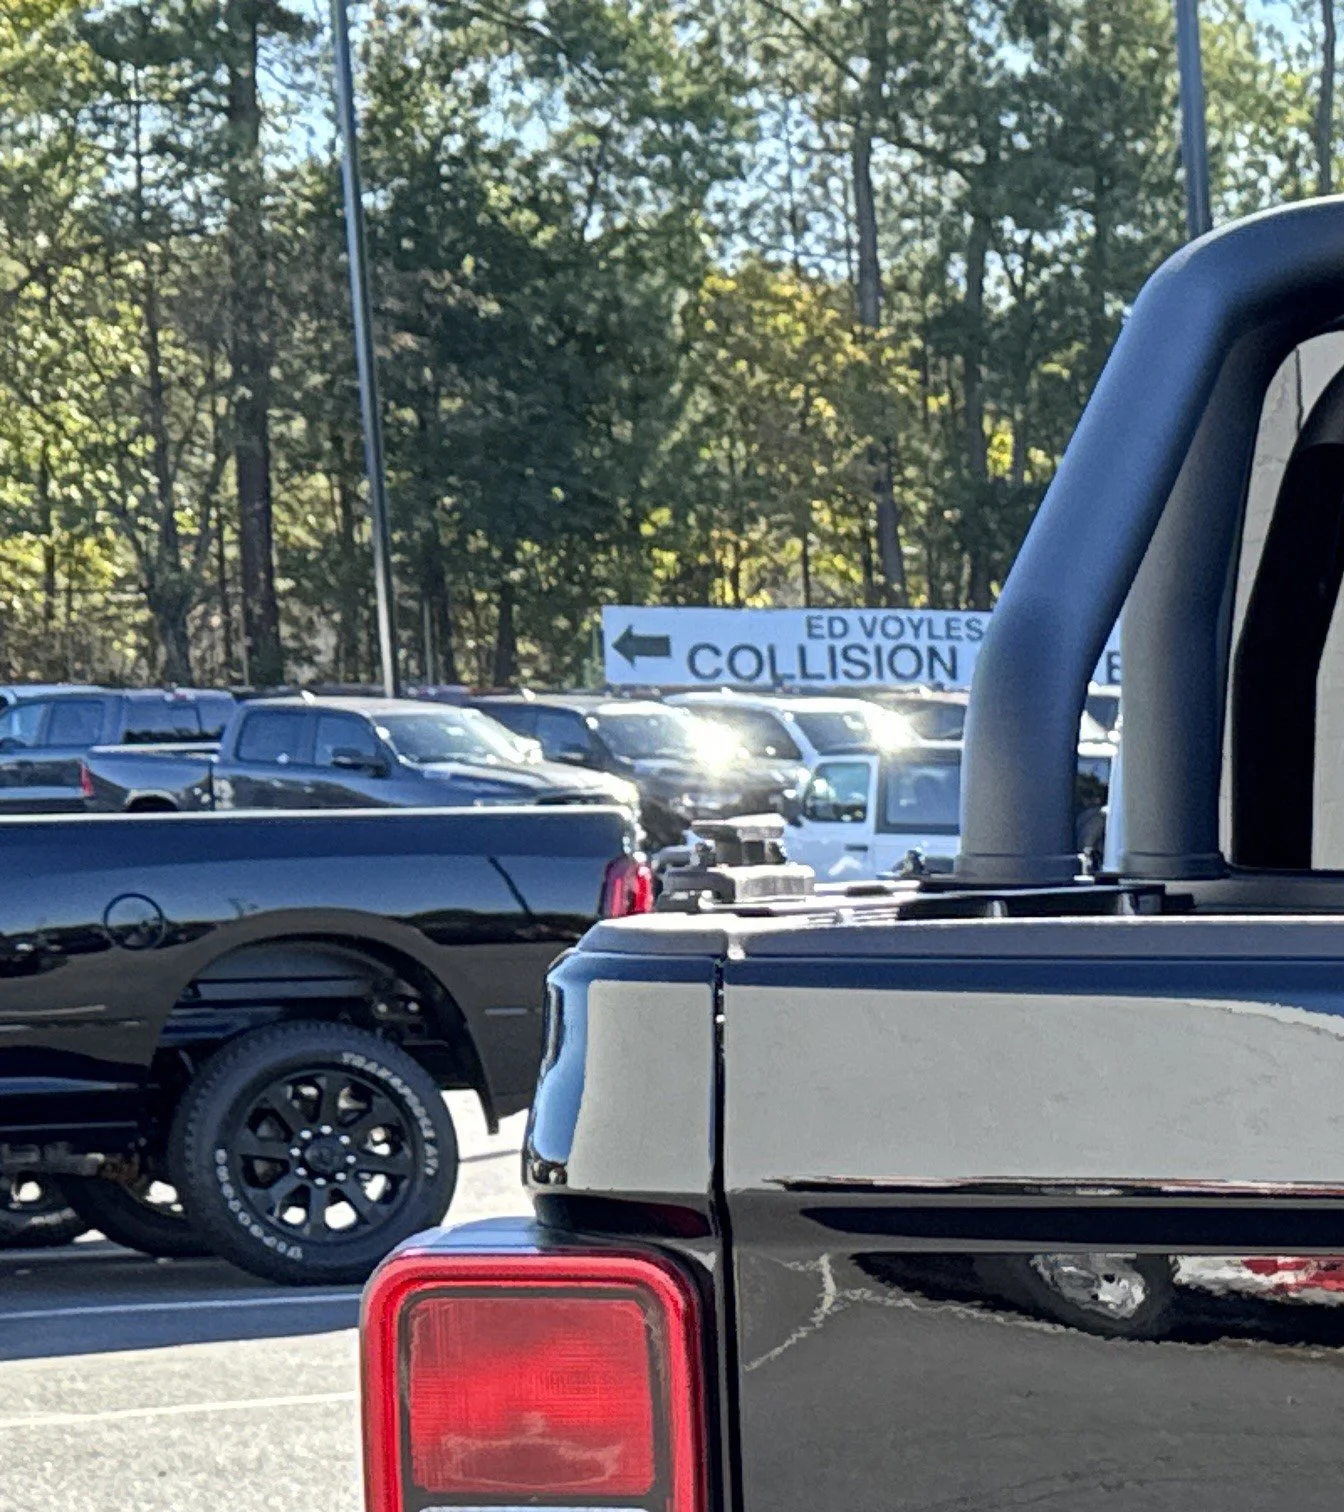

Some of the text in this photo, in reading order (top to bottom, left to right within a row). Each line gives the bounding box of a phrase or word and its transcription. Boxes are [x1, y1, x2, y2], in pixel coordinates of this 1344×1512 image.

[805, 614, 984, 641] ED VOYLES
[687, 643, 958, 681] COLLISION
